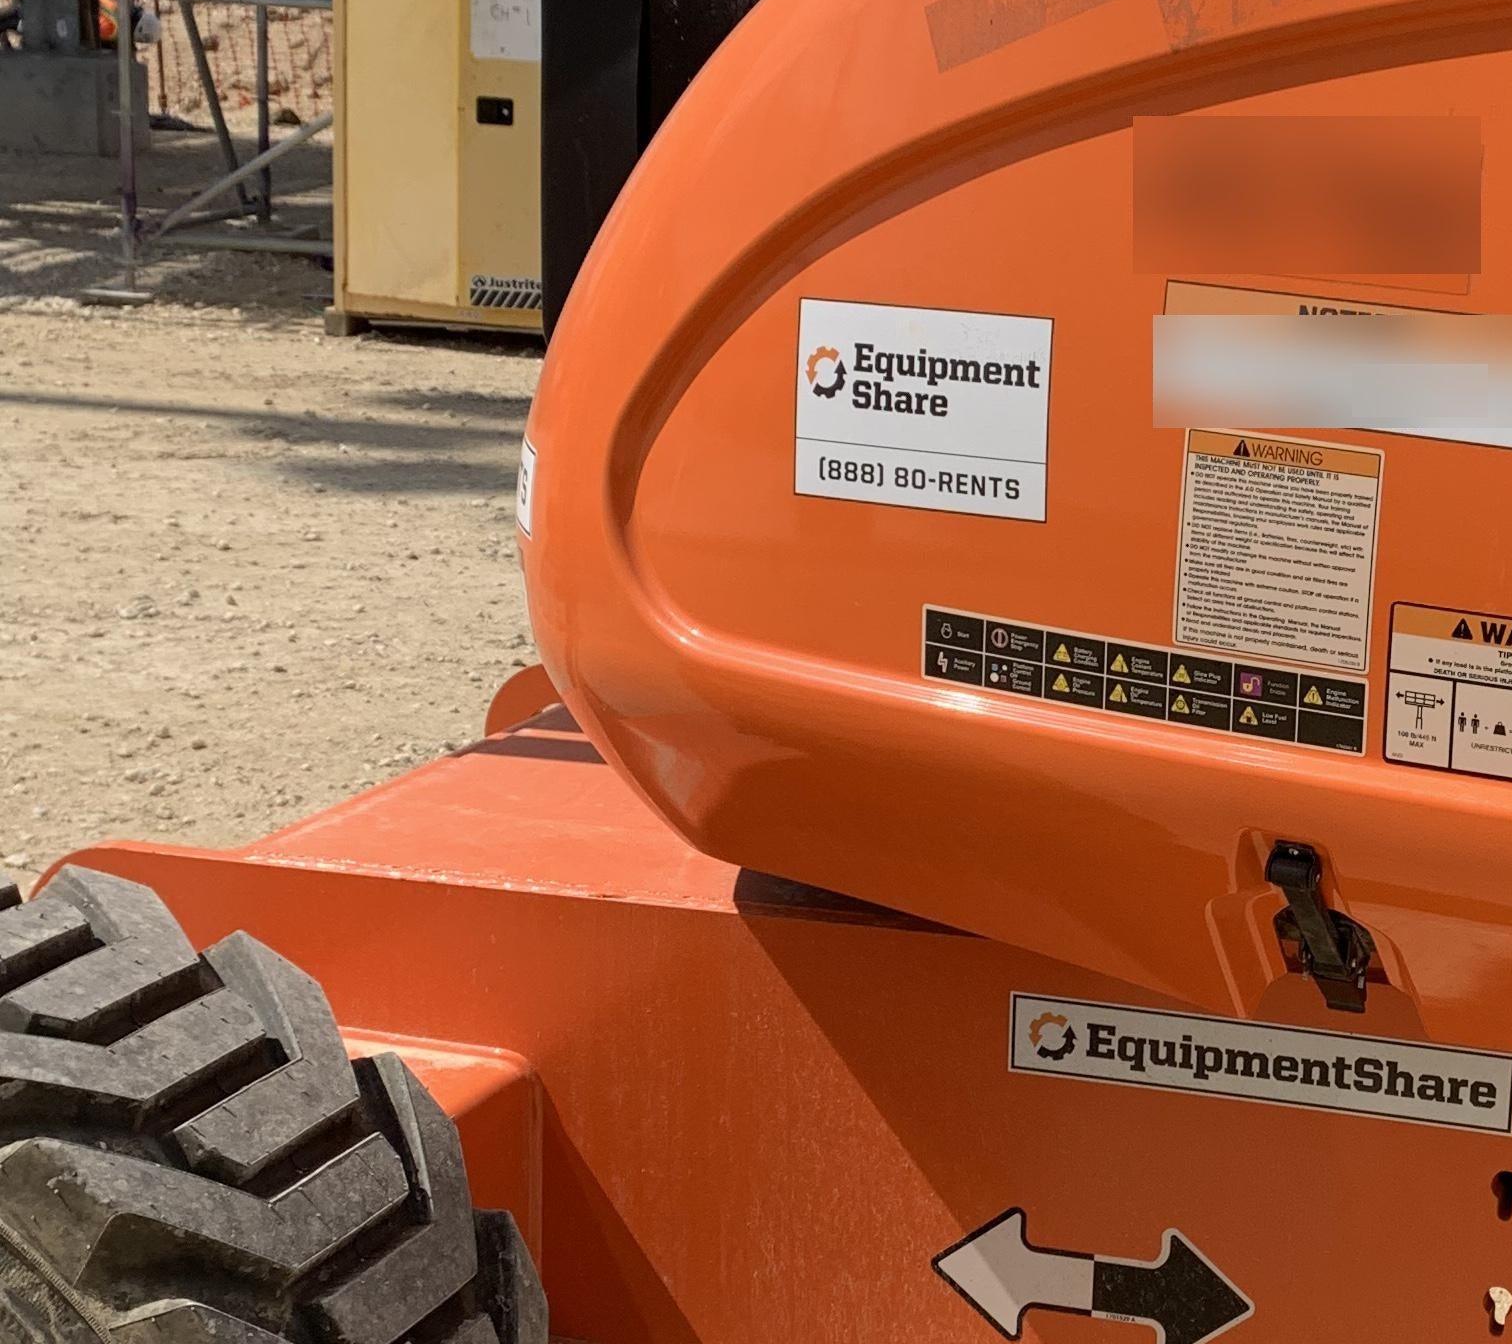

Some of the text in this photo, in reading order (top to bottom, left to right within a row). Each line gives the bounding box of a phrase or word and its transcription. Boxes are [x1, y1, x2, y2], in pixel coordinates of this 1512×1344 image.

[853, 342, 1040, 388] Equipment
[852, 380, 948, 417] Share
[1210, 457, 1241, 466] MACHINE
[1243, 461, 1260, 469] MUST
[1287, 467, 1304, 475] USED
[1307, 469, 1324, 478] UNTIL
[1252, 444, 1324, 466] WARNING
[819, 456, 1020, 500] (888) 80-RENTS
[1194, 462, 1229, 473] INSPECTED
[1232, 467, 1246, 475] AND
[1248, 470, 1285, 482] OPERATING
[1469, 673, 1498, 682] SERIOUS
[1086, 1022, 1497, 1110] EquipmentShare
